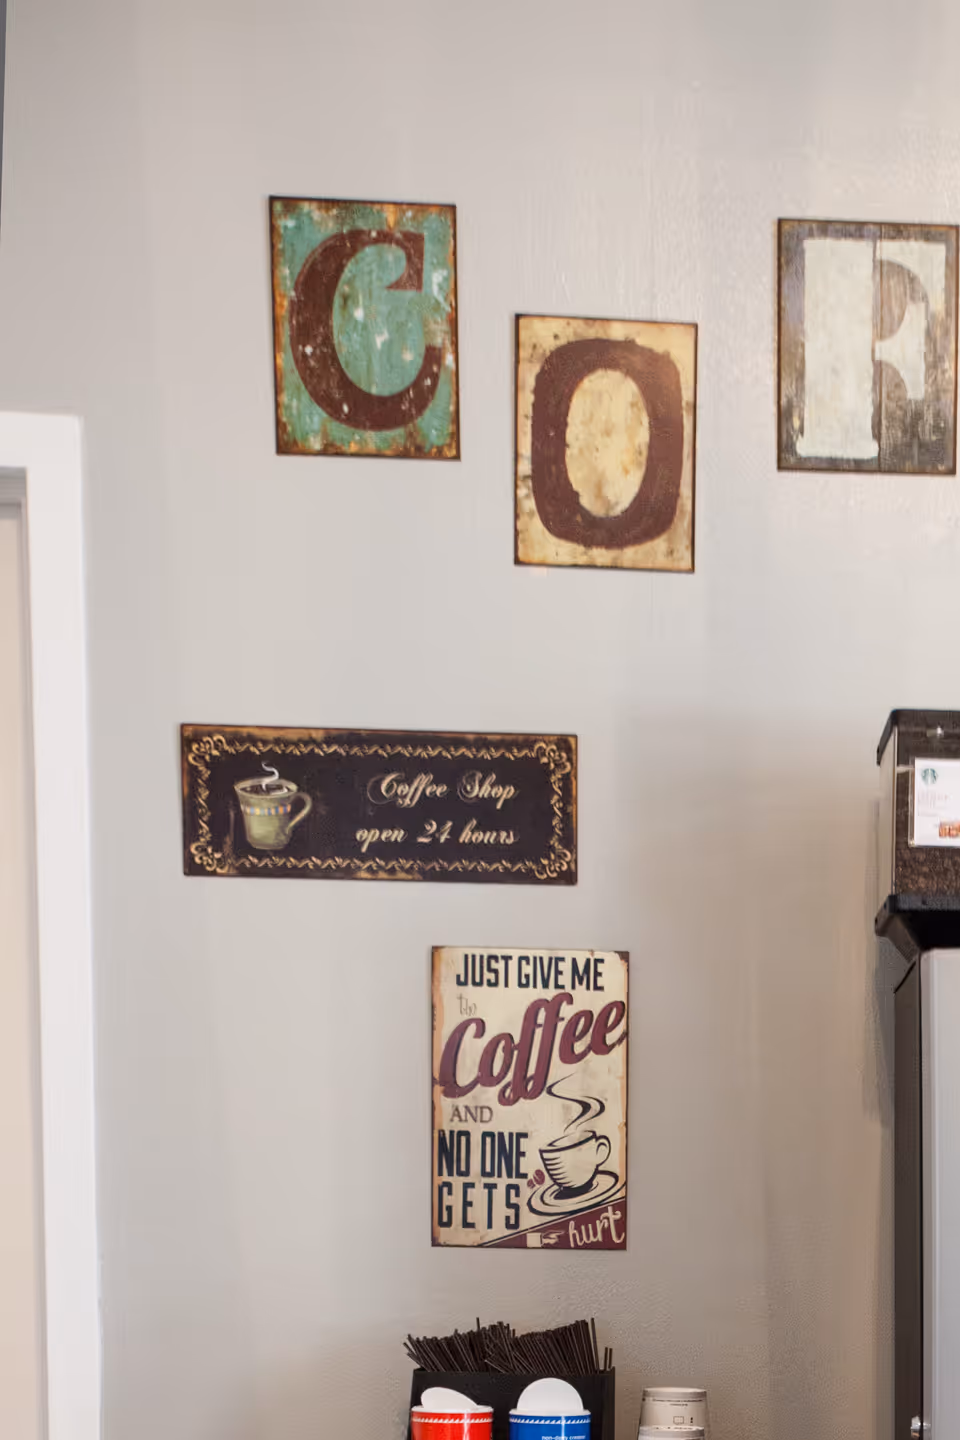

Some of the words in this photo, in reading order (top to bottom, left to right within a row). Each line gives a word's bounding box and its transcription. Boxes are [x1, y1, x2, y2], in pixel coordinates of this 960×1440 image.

[367, 771, 449, 808] Coffee
[457, 770, 516, 809] Shop
[355, 827, 408, 853] open
[416, 819, 453, 843] 24
[458, 818, 517, 845] hours
[456, 954, 513, 988] JUST
[517, 955, 566, 990] GIVE
[571, 957, 605, 992] ME
[434, 992, 627, 1106] Coffee
[450, 1105, 493, 1123] AND
[437, 1129, 471, 1177] NO
[481, 1131, 528, 1179] ONE
[437, 1181, 520, 1230] GETS
[569, 1206, 625, 1248] hurt
